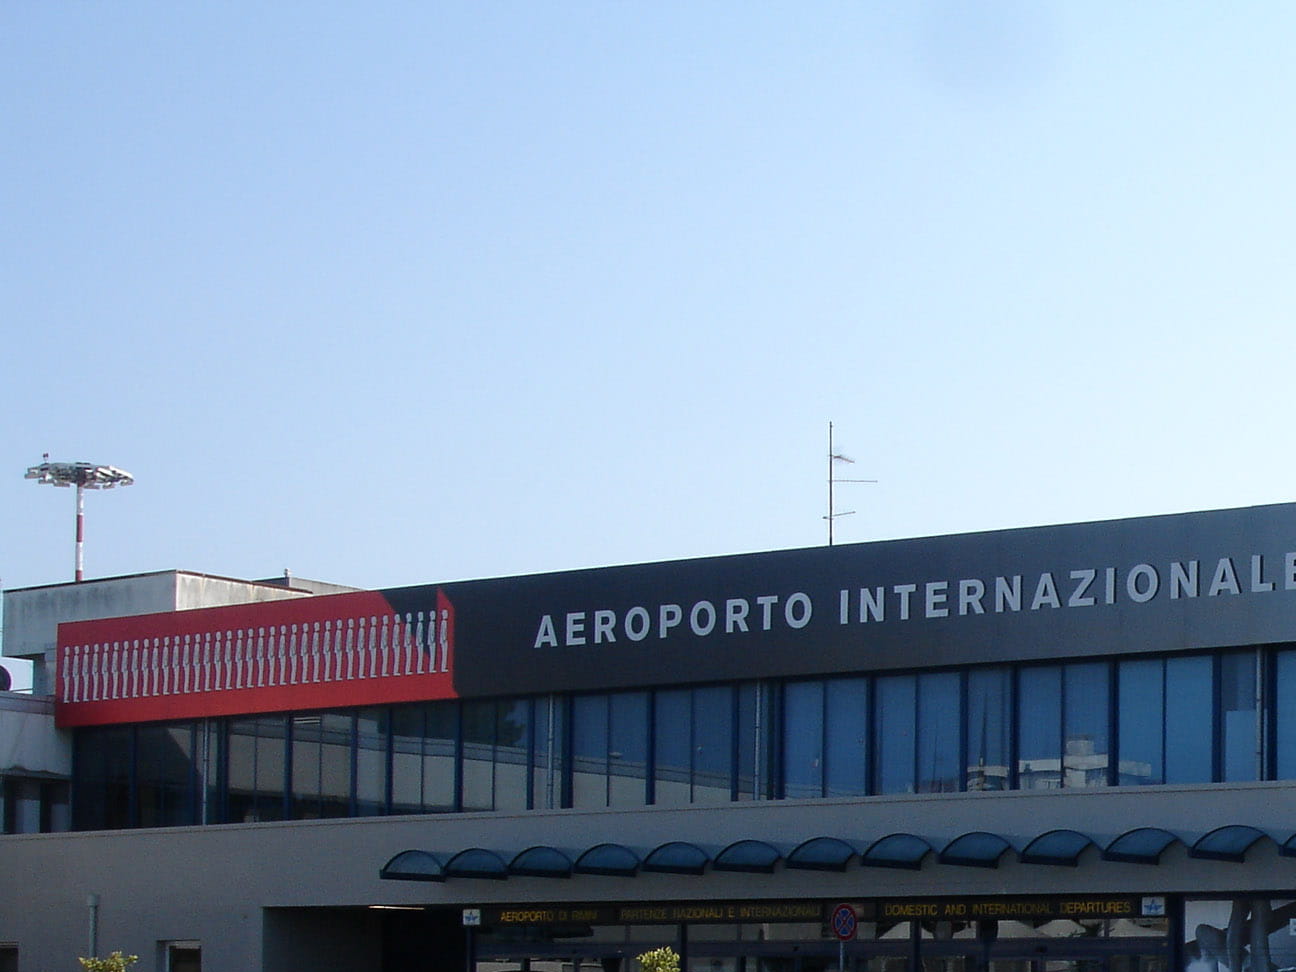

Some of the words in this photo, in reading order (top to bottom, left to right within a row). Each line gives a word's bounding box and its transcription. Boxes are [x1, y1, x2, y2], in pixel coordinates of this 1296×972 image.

[533, 592, 812, 648] AEROPORTO
[500, 911, 553, 921] AEROPORTO
[620, 910, 667, 920] PARTENZE
[673, 907, 724, 919] NAZIONALI
[729, 907, 735, 918] E
[740, 904, 821, 918] INTERNAZIONALI
[885, 904, 938, 916] DOMESTIC
[944, 904, 967, 915] AND
[973, 903, 1053, 915] INTERNATIONAL
[1060, 901, 1132, 914] DEPARTURES
